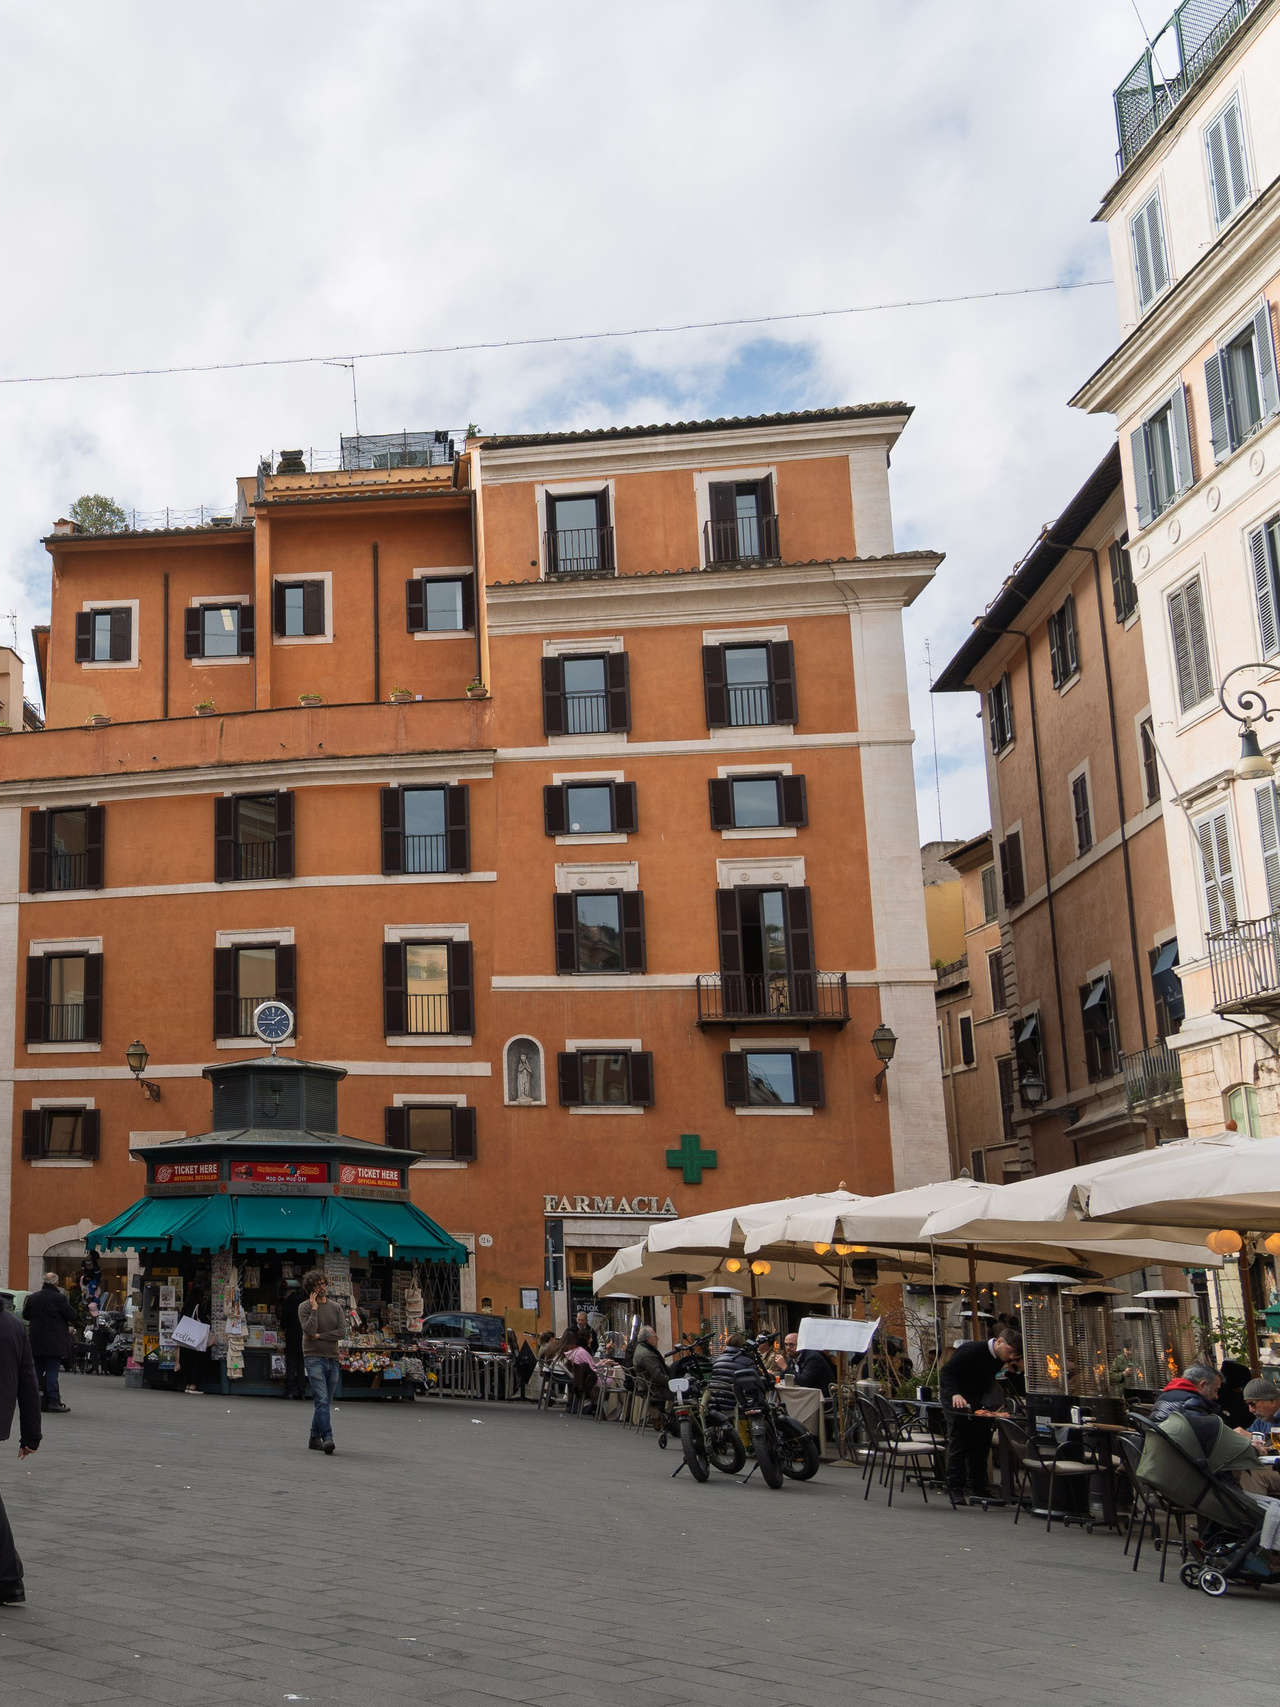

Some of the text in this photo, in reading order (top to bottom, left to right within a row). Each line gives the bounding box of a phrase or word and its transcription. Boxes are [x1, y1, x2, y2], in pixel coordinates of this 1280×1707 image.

[174, 1164, 218, 1174] TICKET HERE
[300, 1165, 320, 1175] Roma
[357, 1168, 399, 1180] TICKET HERE
[543, 1195, 678, 1214] FARMACIA
[576, 1304, 599, 1312] P-TIOX
